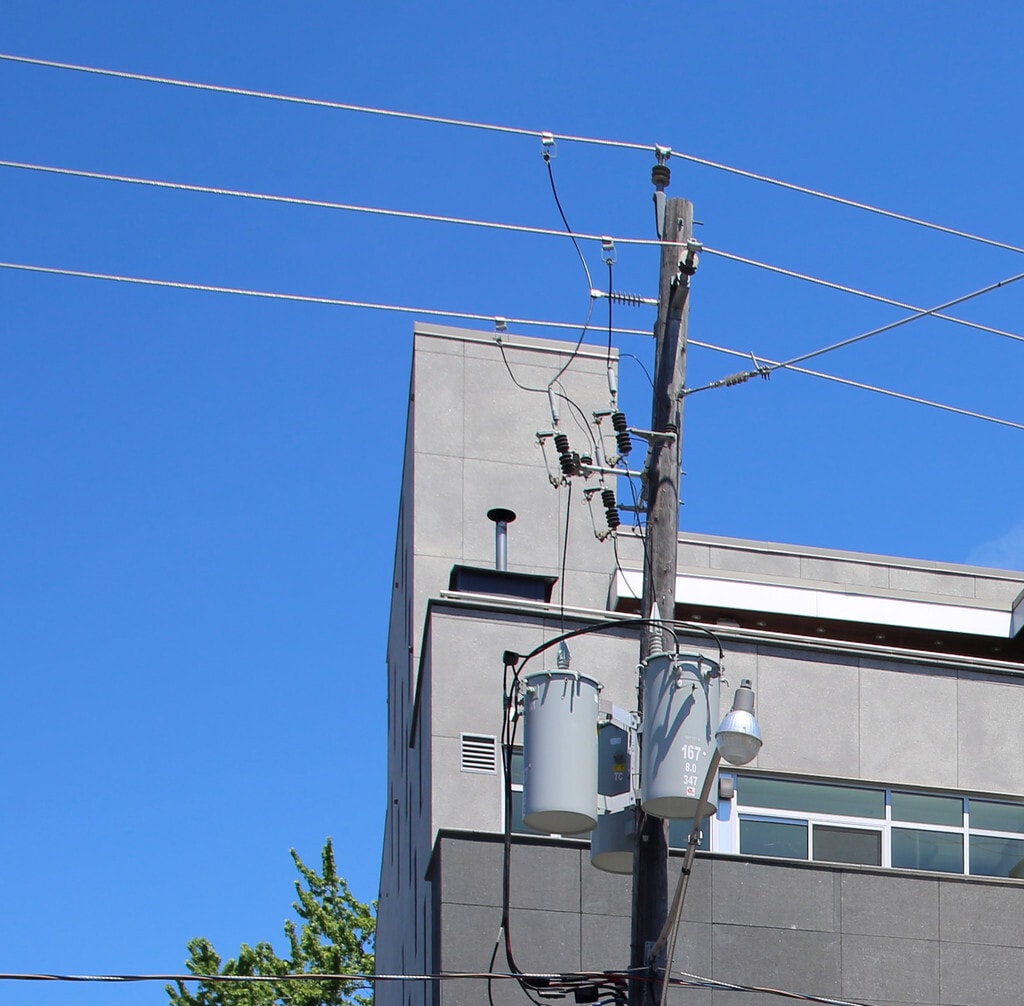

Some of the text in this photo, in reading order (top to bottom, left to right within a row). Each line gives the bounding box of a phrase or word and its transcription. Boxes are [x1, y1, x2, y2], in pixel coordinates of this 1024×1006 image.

[681, 744, 701, 760] 167
[685, 762, 697, 773] 8.0
[613, 772, 624, 781] TC
[683, 775, 698, 786] 347
